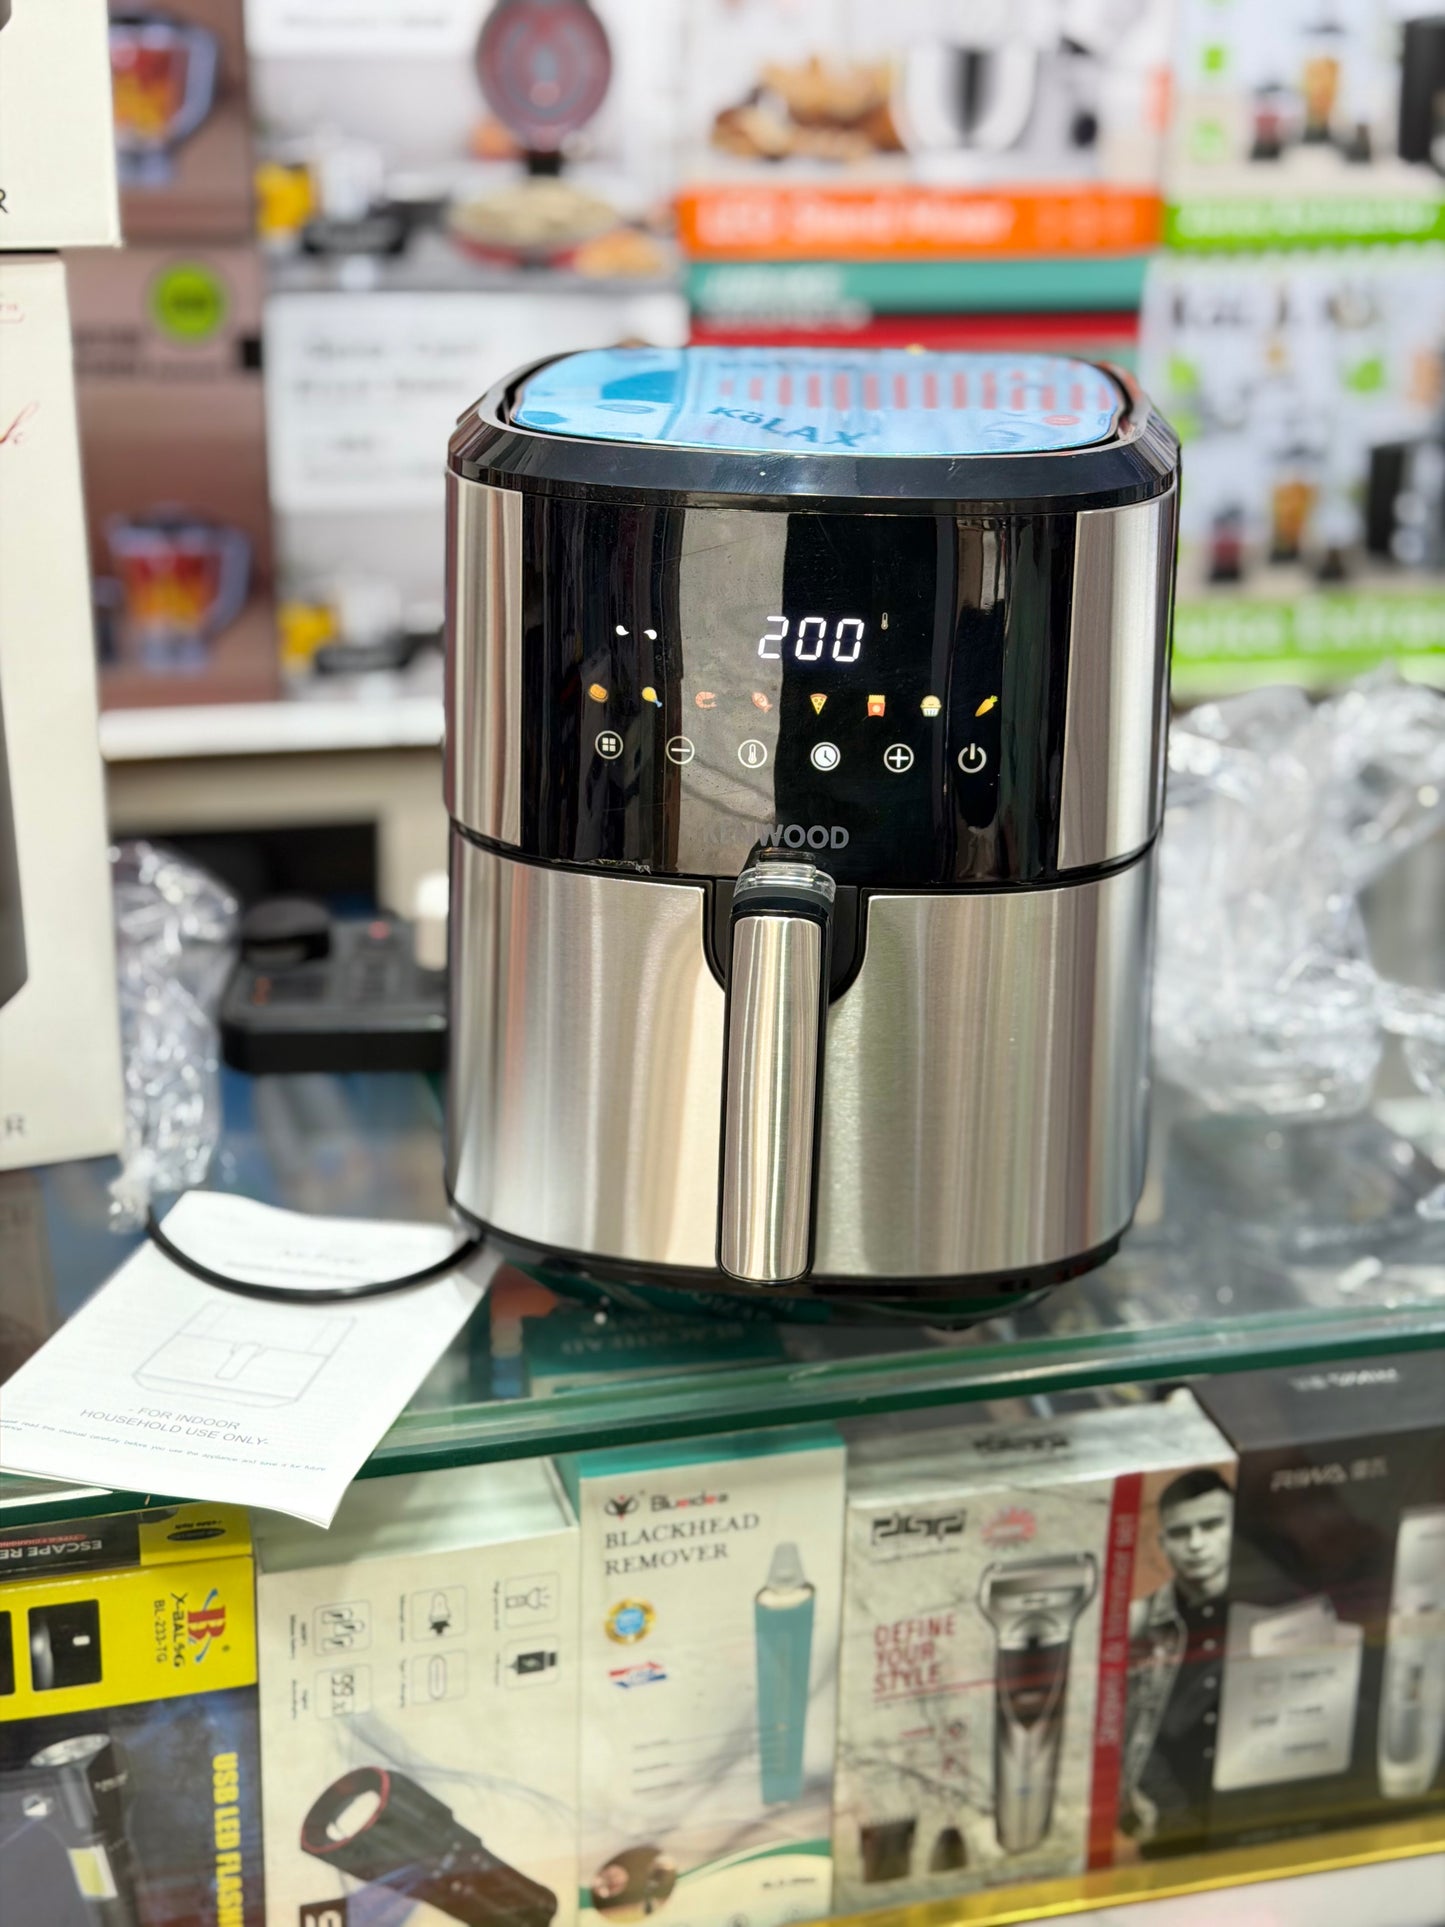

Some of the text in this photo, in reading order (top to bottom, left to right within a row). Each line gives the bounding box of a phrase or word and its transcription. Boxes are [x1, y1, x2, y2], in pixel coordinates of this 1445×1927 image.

[758, 615, 864, 662] 200
[80, 1408, 182, 1433] HOUSEHOLD
[185, 1426, 220, 1440] USE
[138, 1407, 172, 1420] FOR
[176, 1413, 241, 1430] INDOOR
[606, 1513, 760, 1549] BLACKHEAD
[28, 1539, 103, 1557] ESCAPE
[605, 1543, 729, 1576] REMOVER
[875, 1613, 955, 1646] DEFINE
[875, 1639, 935, 1669] YOUR
[873, 1664, 938, 1694] STYLE
[212, 1752, 239, 1804] USB
[214, 1806, 240, 1849] LED
